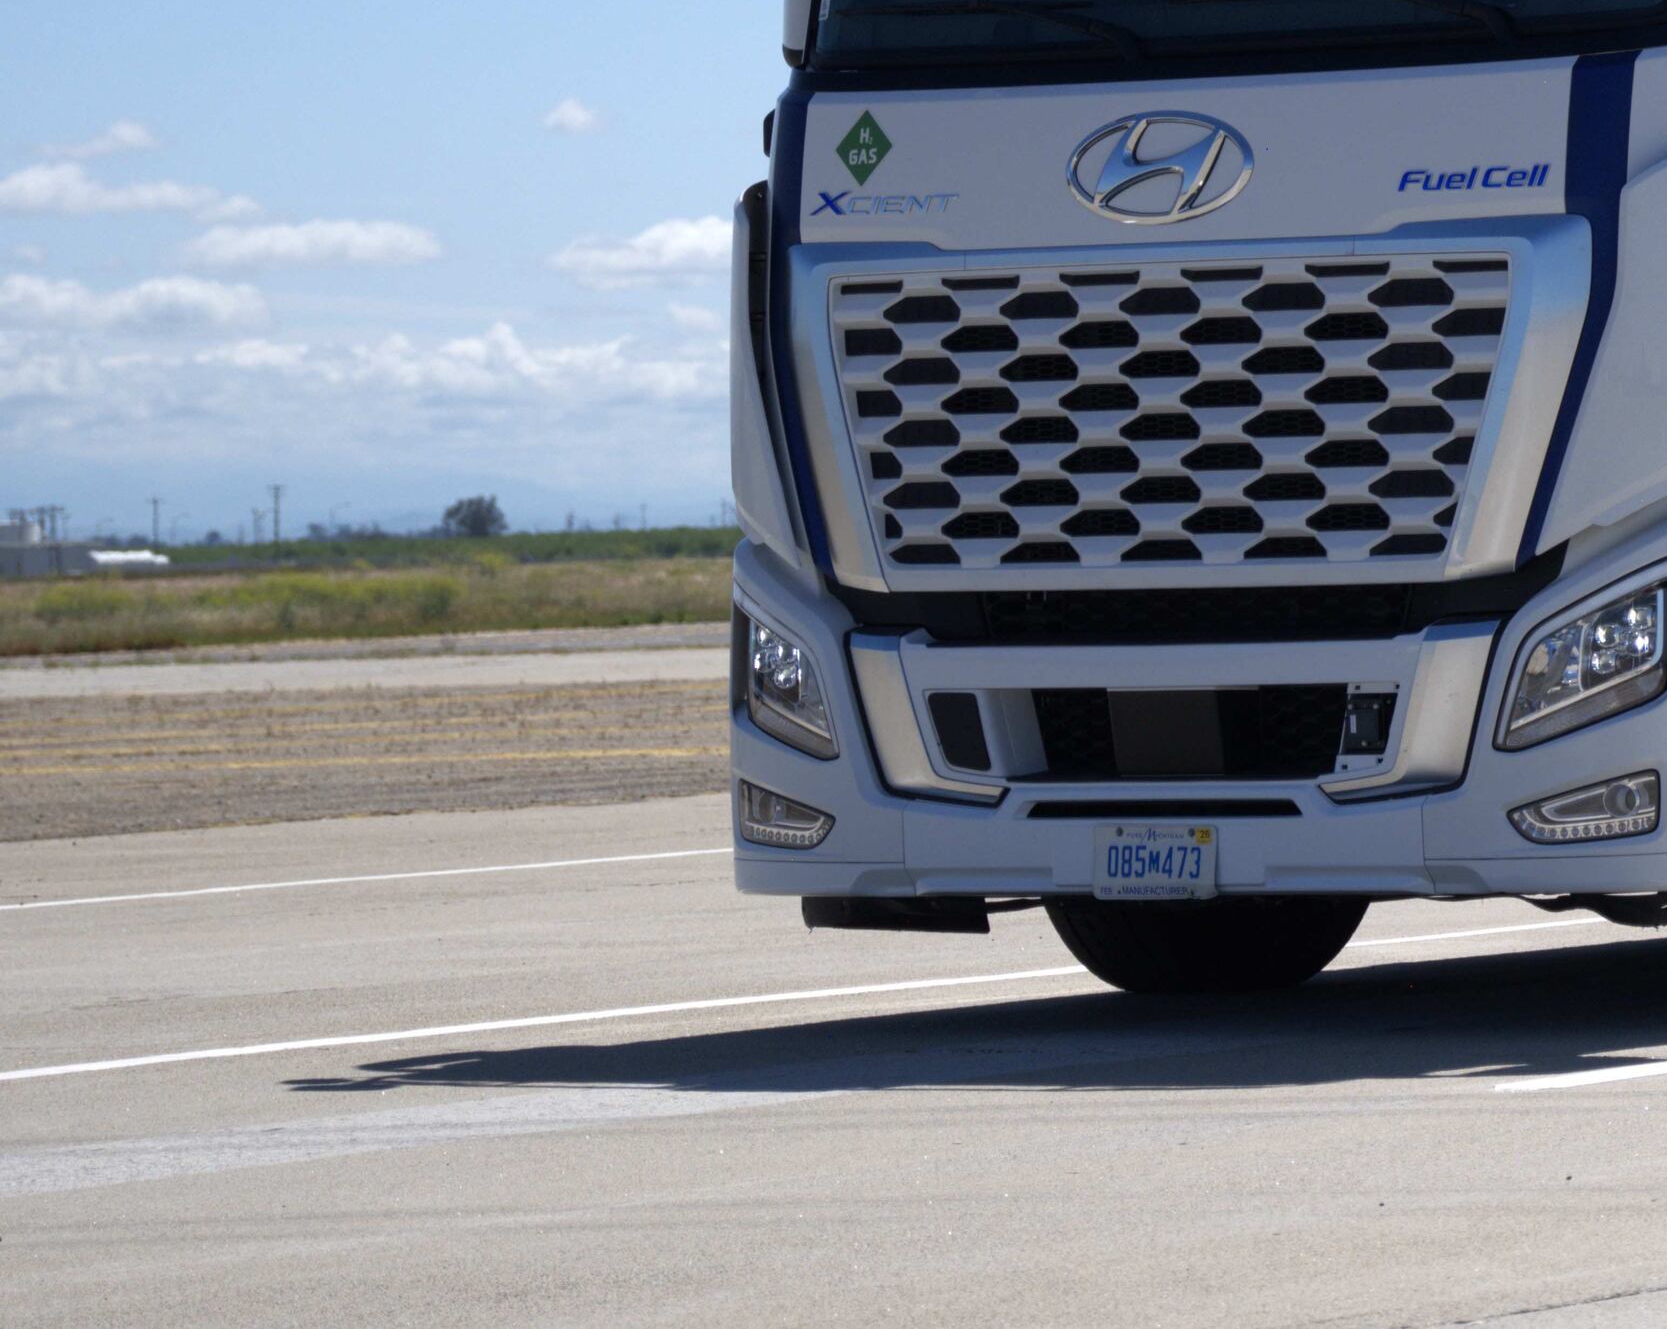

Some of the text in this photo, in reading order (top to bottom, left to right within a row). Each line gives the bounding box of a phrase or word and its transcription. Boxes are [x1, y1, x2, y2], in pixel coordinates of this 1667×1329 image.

[849, 148, 878, 165] GAS
[1397, 164, 1550, 192] Fuel Cell
[809, 190, 960, 216] XCIENT
[1107, 844, 1202, 879] 085M473
